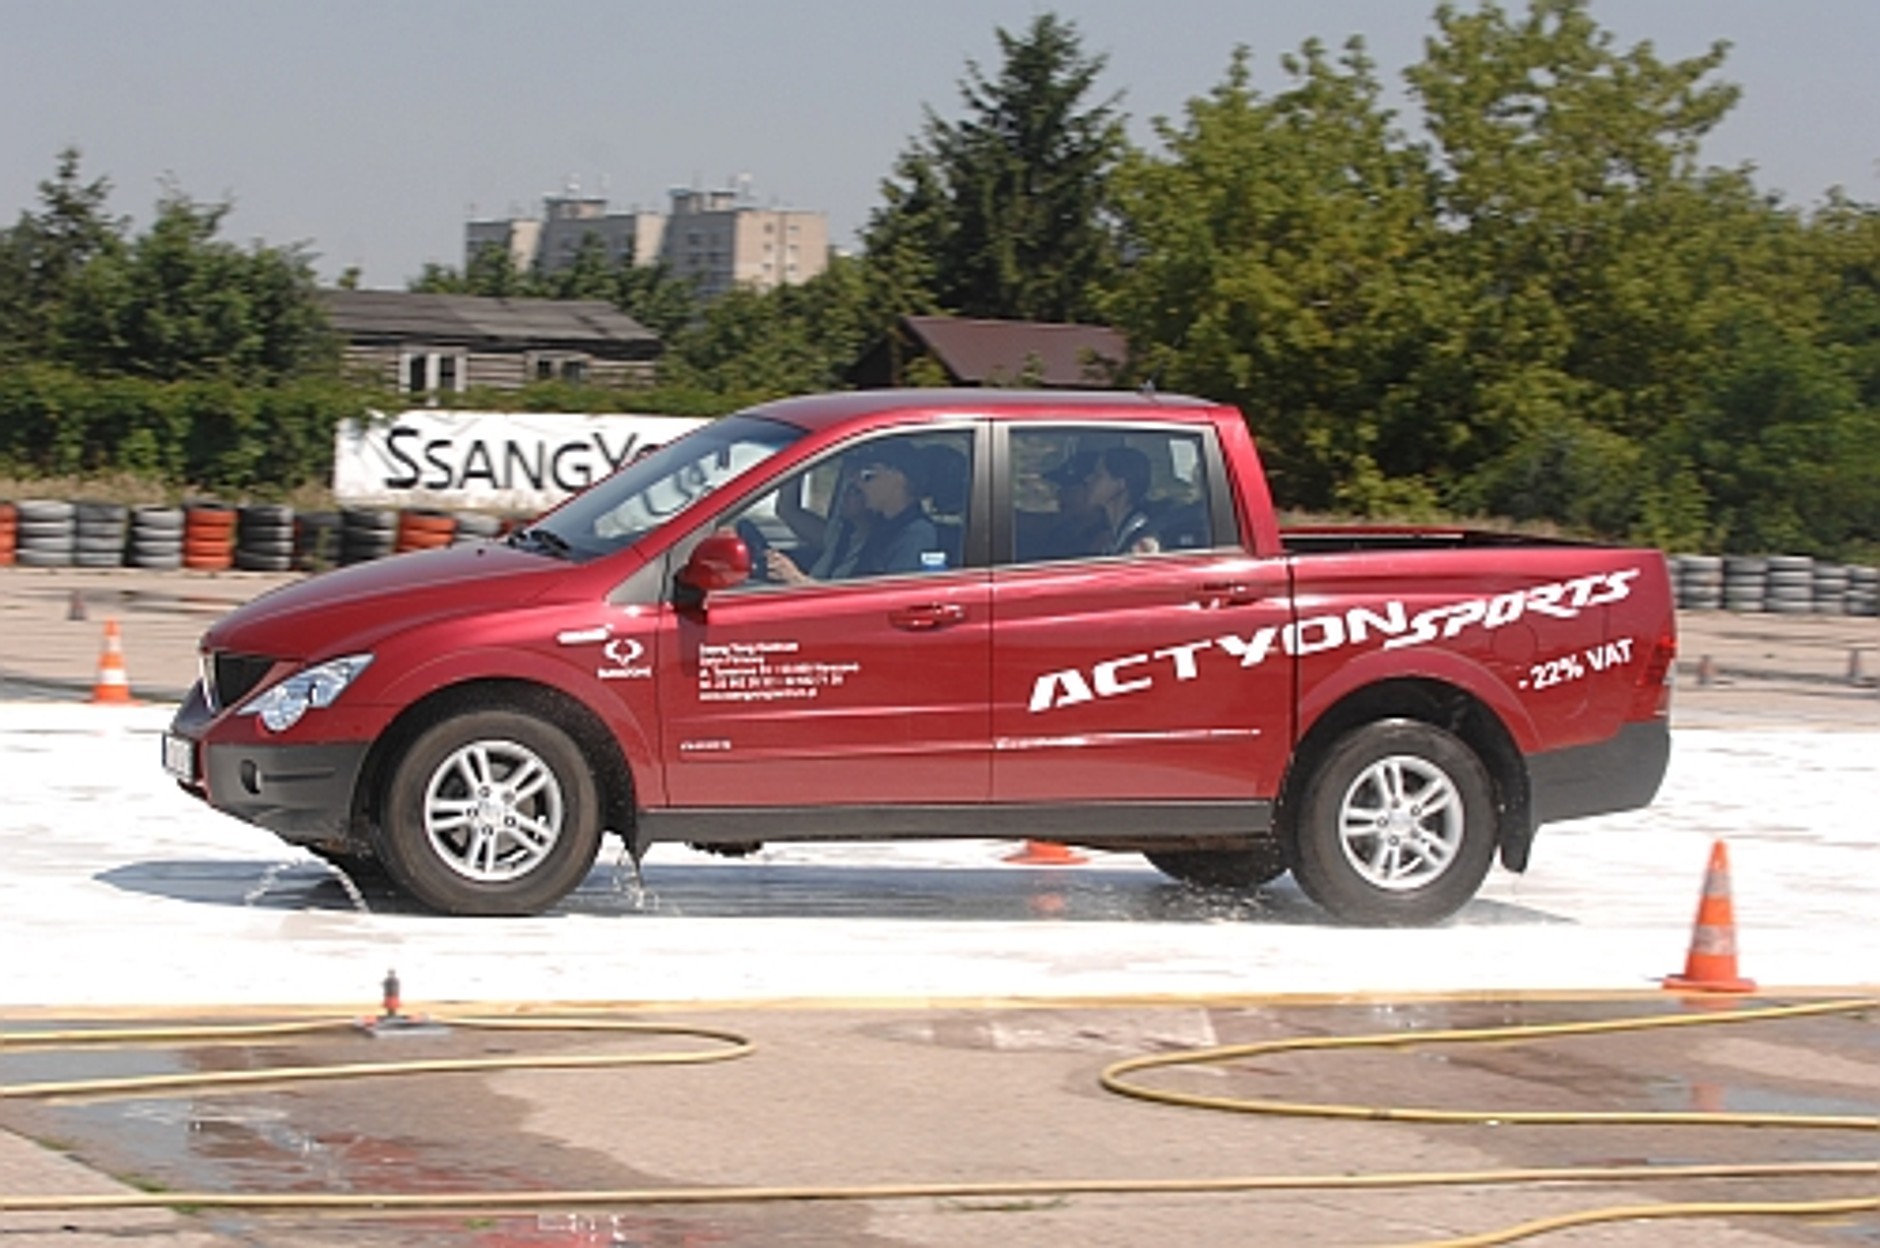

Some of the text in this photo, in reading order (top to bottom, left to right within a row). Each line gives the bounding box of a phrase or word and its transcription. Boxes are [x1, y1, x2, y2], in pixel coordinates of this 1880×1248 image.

[384, 427, 661, 493] SSANGY
[1029, 569, 1639, 712] ACTYON SPORTS
[1585, 638, 1633, 672] VAT
